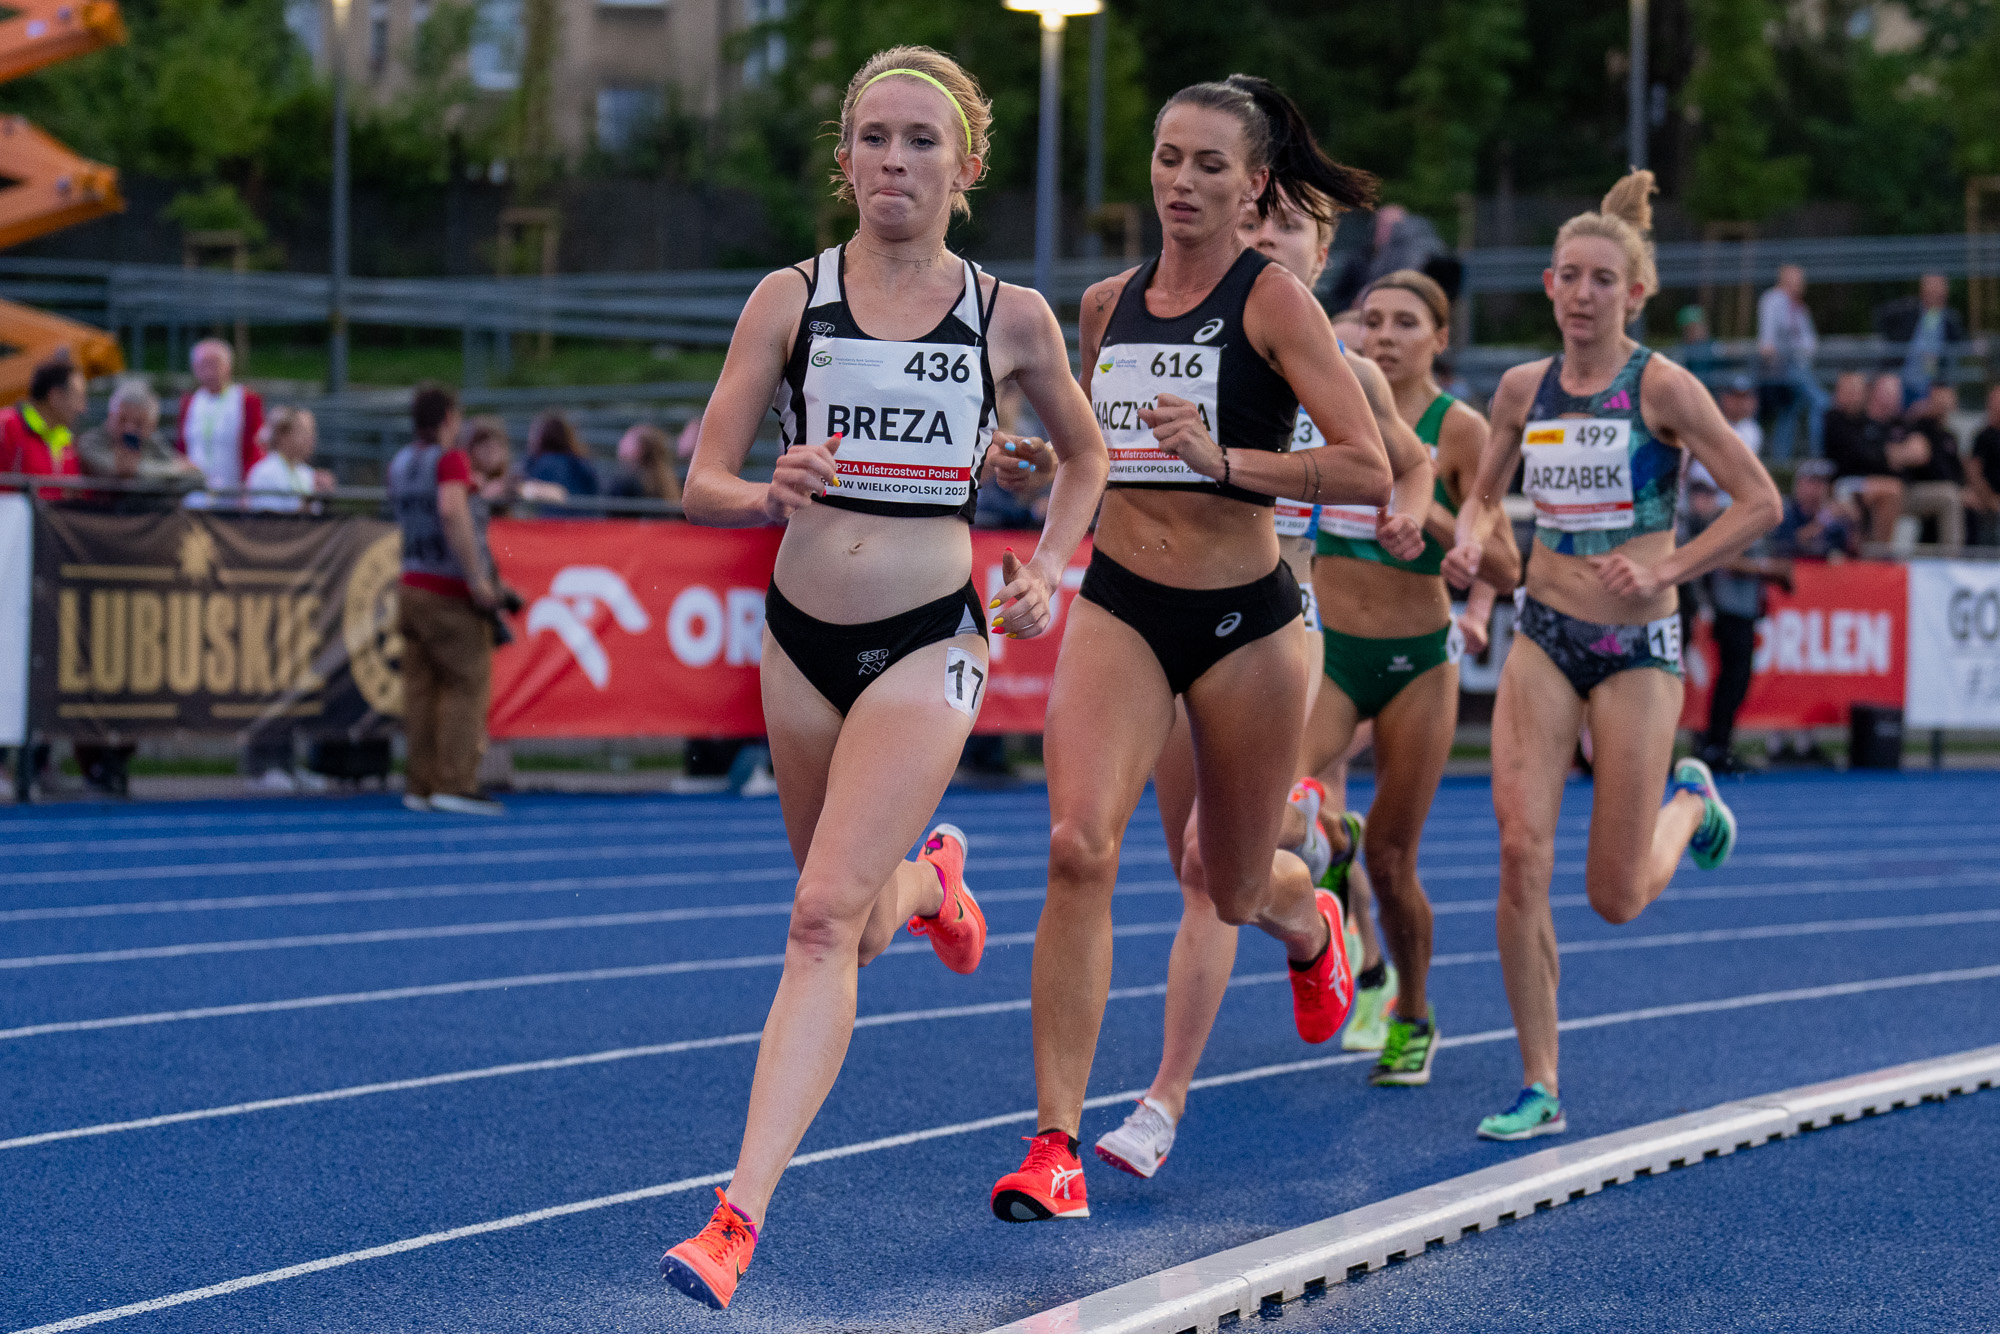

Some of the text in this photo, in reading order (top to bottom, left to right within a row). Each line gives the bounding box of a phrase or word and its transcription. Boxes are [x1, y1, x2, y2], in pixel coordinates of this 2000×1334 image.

[903, 351, 971, 384] 436
[1150, 351, 1203, 379] 616
[826, 403, 953, 446] BREZA
[1575, 425, 1617, 446] 499
[835, 462, 959, 480] PZLA Mistrzostwa Polski
[1117, 464, 1184, 474] WIELKOPOLSKI
[857, 480, 943, 496] WIELKOPOLSKI
[944, 486, 967, 497] 2023
[58, 587, 326, 695] LUBUSKIE
[947, 658, 985, 711] 17
